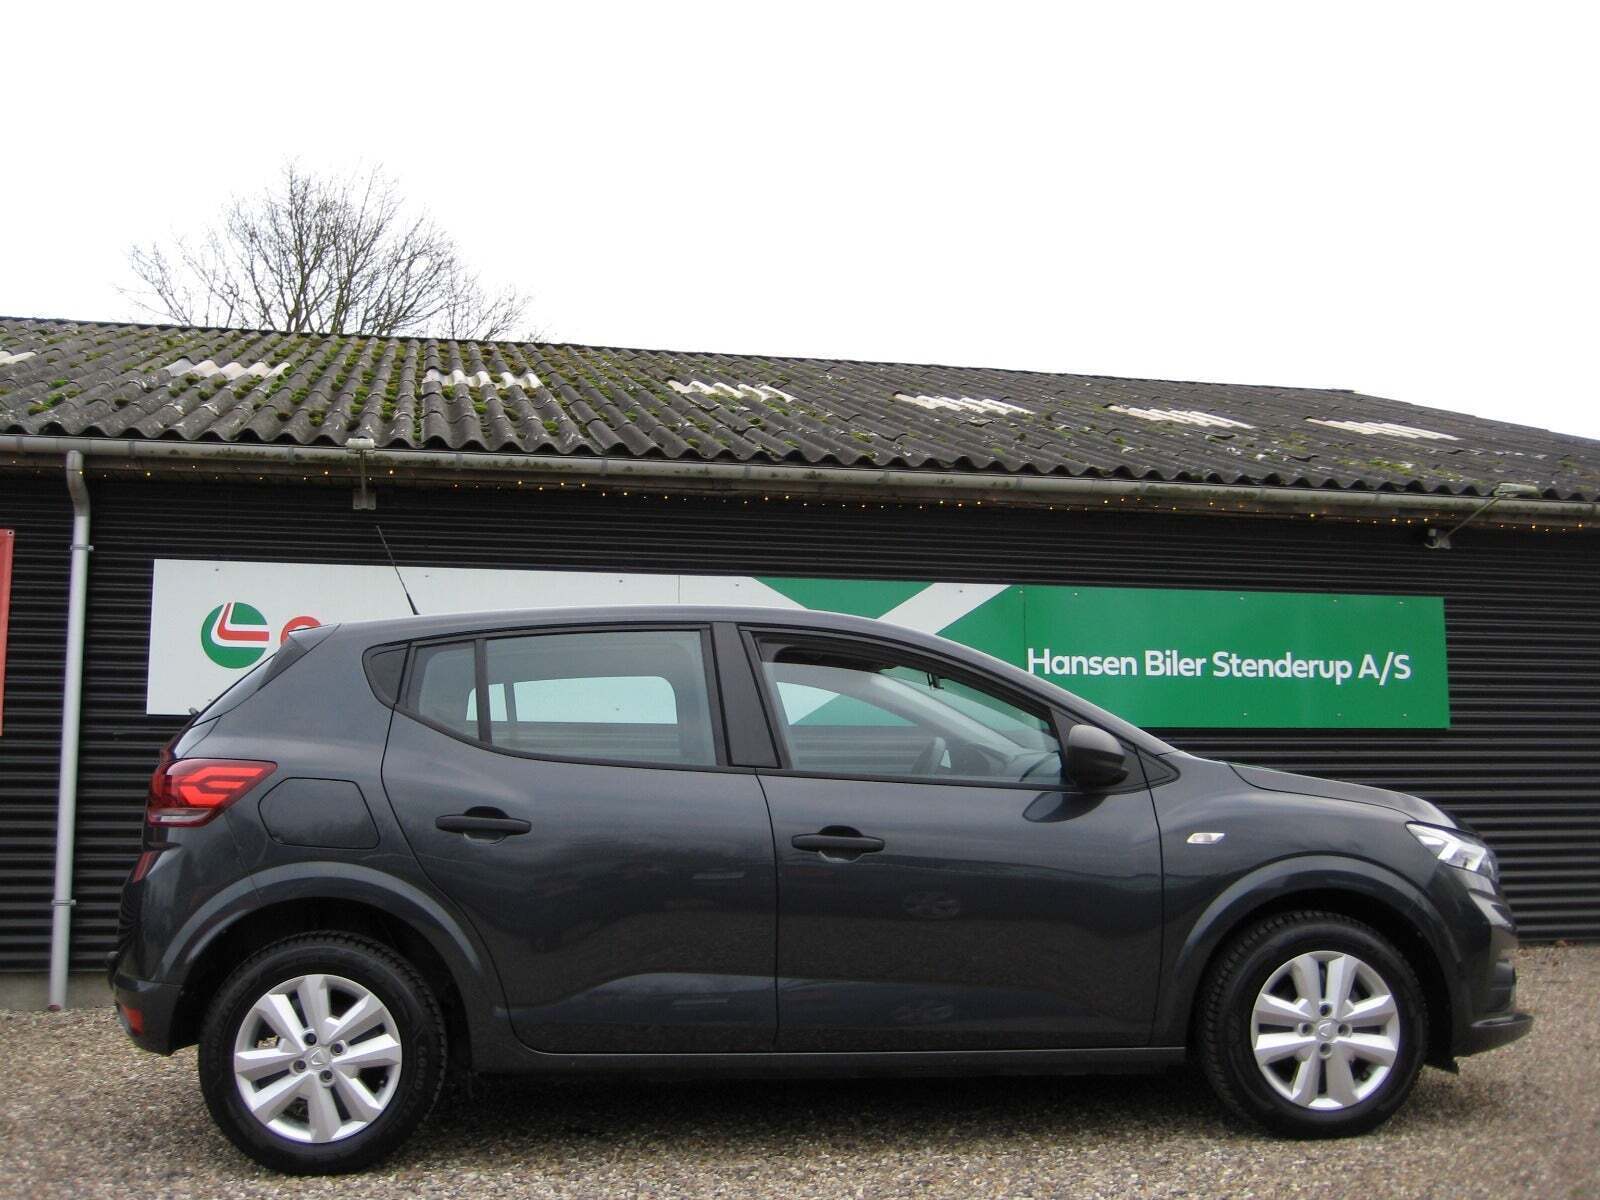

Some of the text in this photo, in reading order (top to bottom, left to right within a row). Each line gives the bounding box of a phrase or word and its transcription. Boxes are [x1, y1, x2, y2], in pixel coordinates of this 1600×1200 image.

[1027, 648, 1412, 686] Hansen Biler Stenderup A/S
